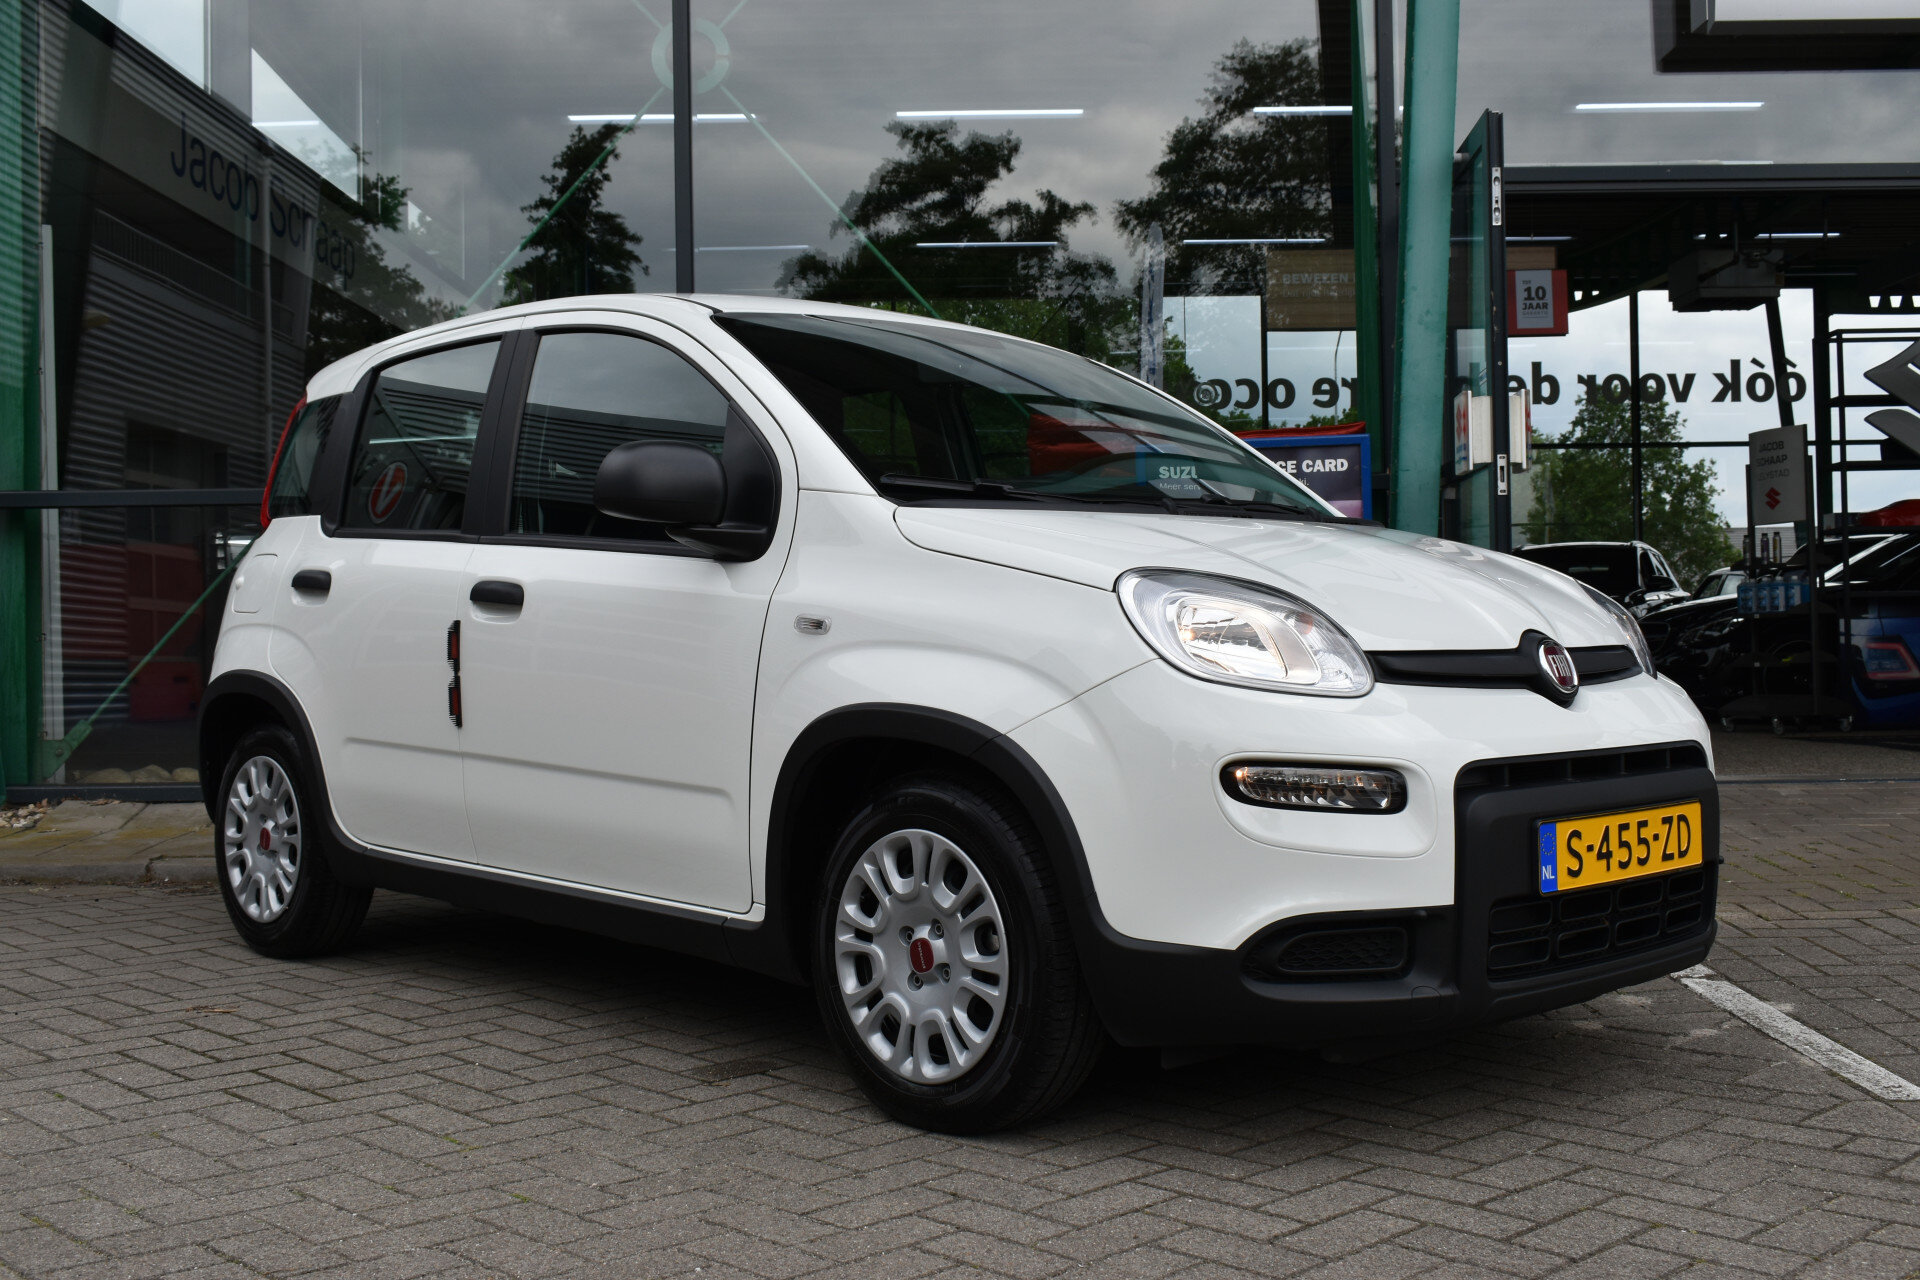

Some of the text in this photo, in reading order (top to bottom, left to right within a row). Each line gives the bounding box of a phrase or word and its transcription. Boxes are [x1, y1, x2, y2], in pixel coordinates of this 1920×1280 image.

[171, 112, 355, 290] Jacob Schaap
[1524, 286, 1547, 301] 10
[1522, 302, 1549, 310] JAAR
[1302, 458, 1349, 473] CARD
[1547, 654, 1571, 677] FIAT
[1566, 813, 1691, 878] S-455-ZD
[1542, 864, 1555, 881] NL
